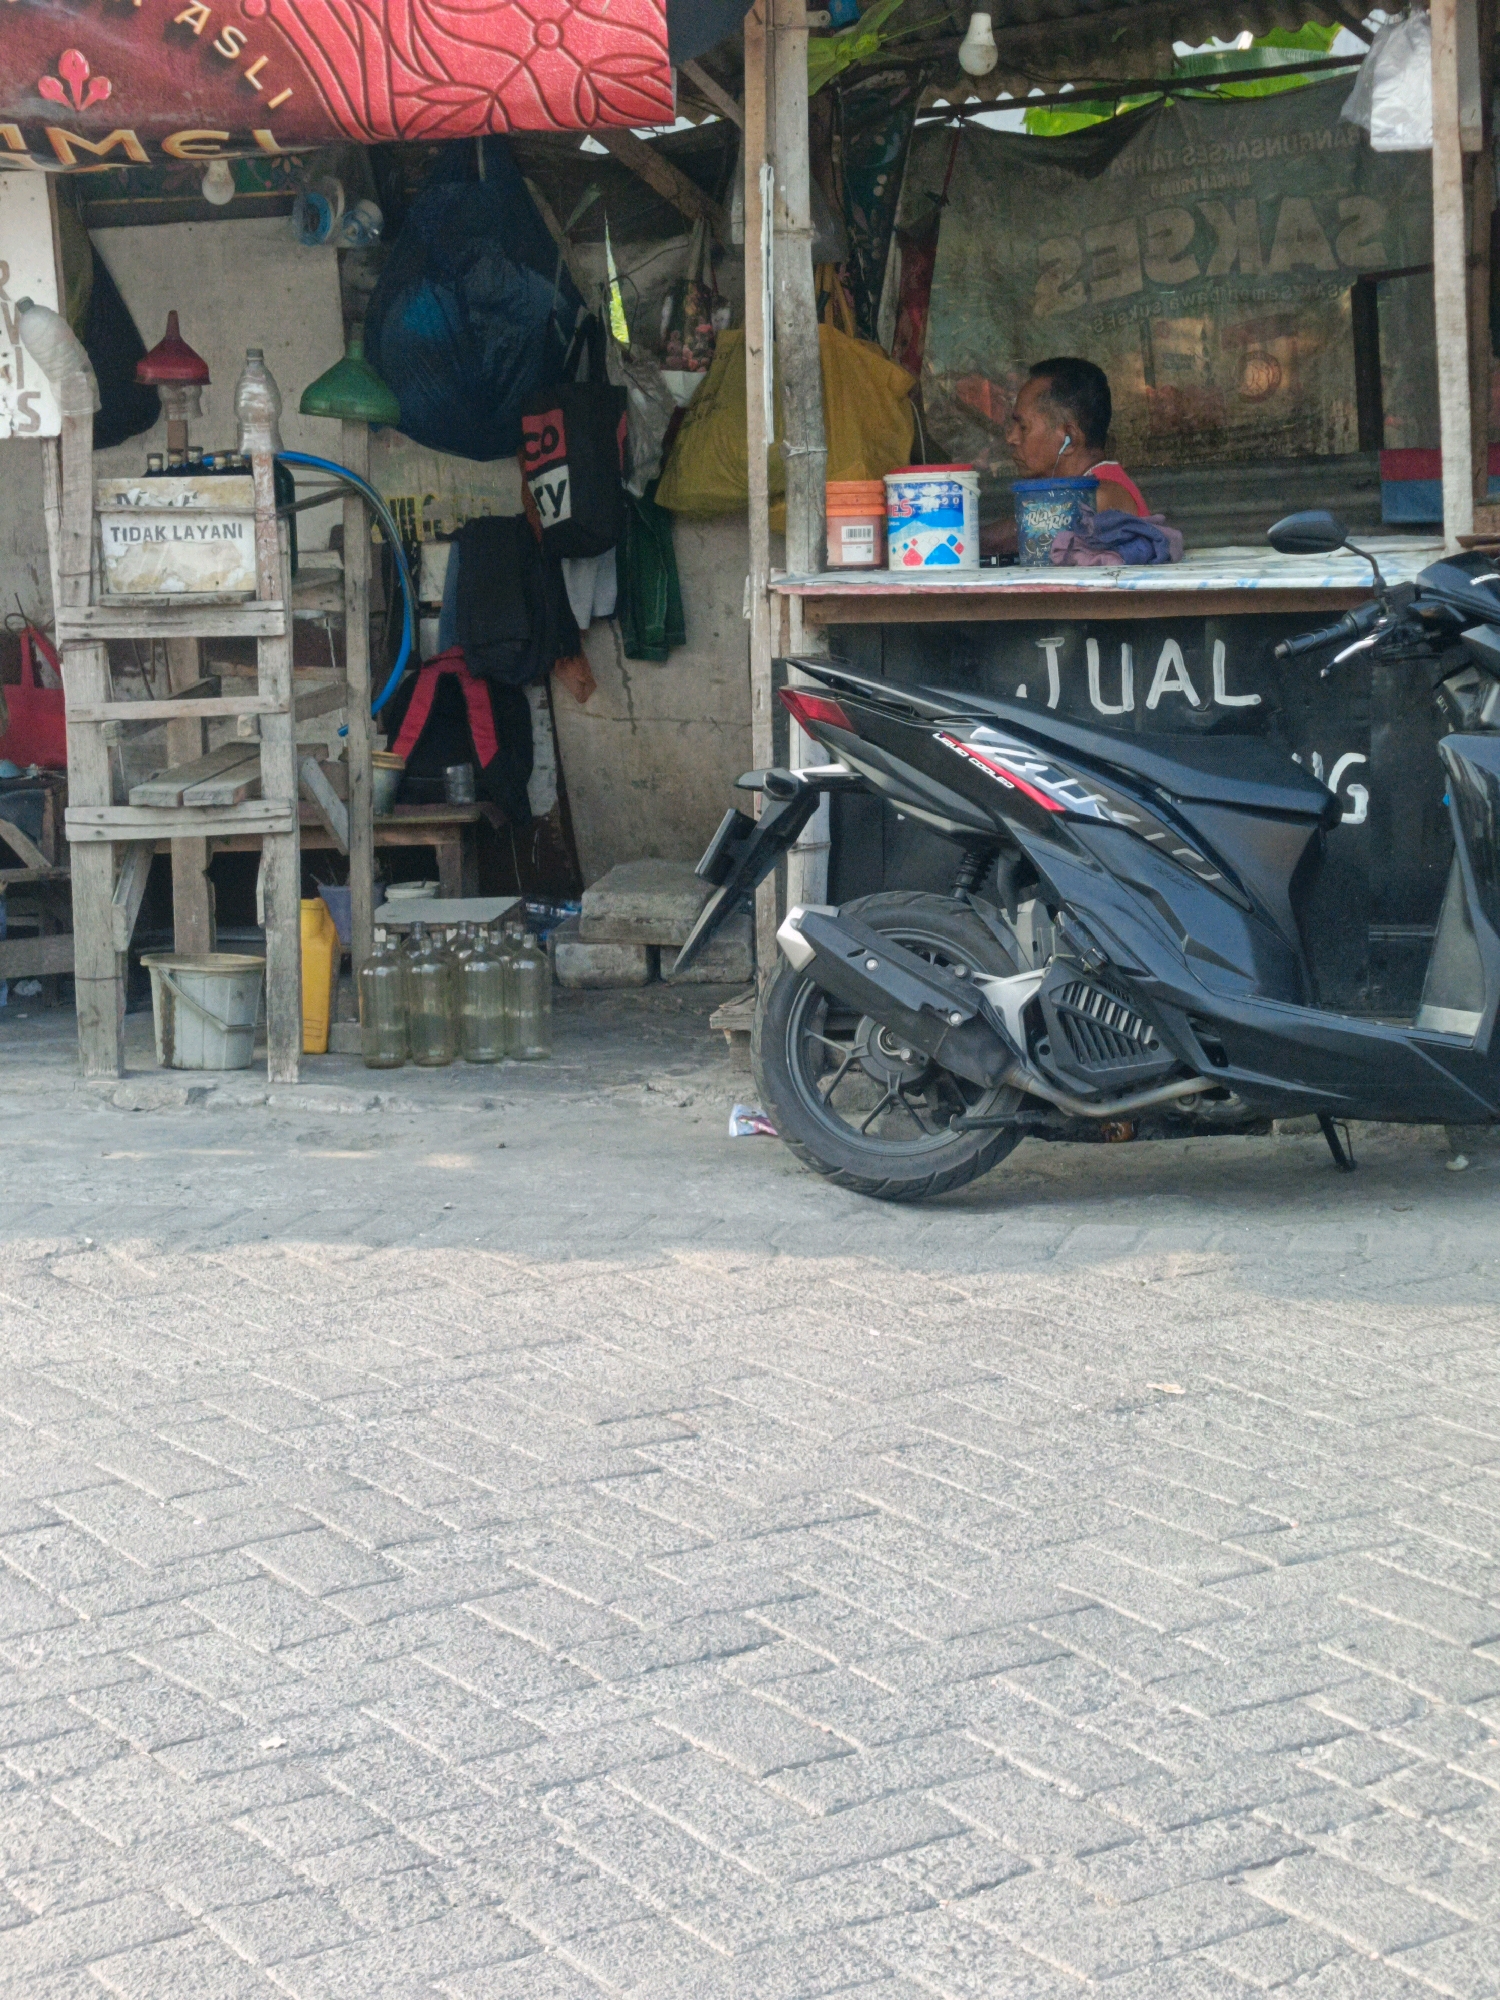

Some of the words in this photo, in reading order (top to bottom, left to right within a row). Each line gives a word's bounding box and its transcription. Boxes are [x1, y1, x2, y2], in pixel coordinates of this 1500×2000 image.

[174, 0, 294, 109] ASLI
[110, 524, 166, 543] TIDAK
[173, 522, 243, 541] LAYANI
[1016, 637, 1262, 715] JUAL
[968, 757, 1015, 789] COOLED
